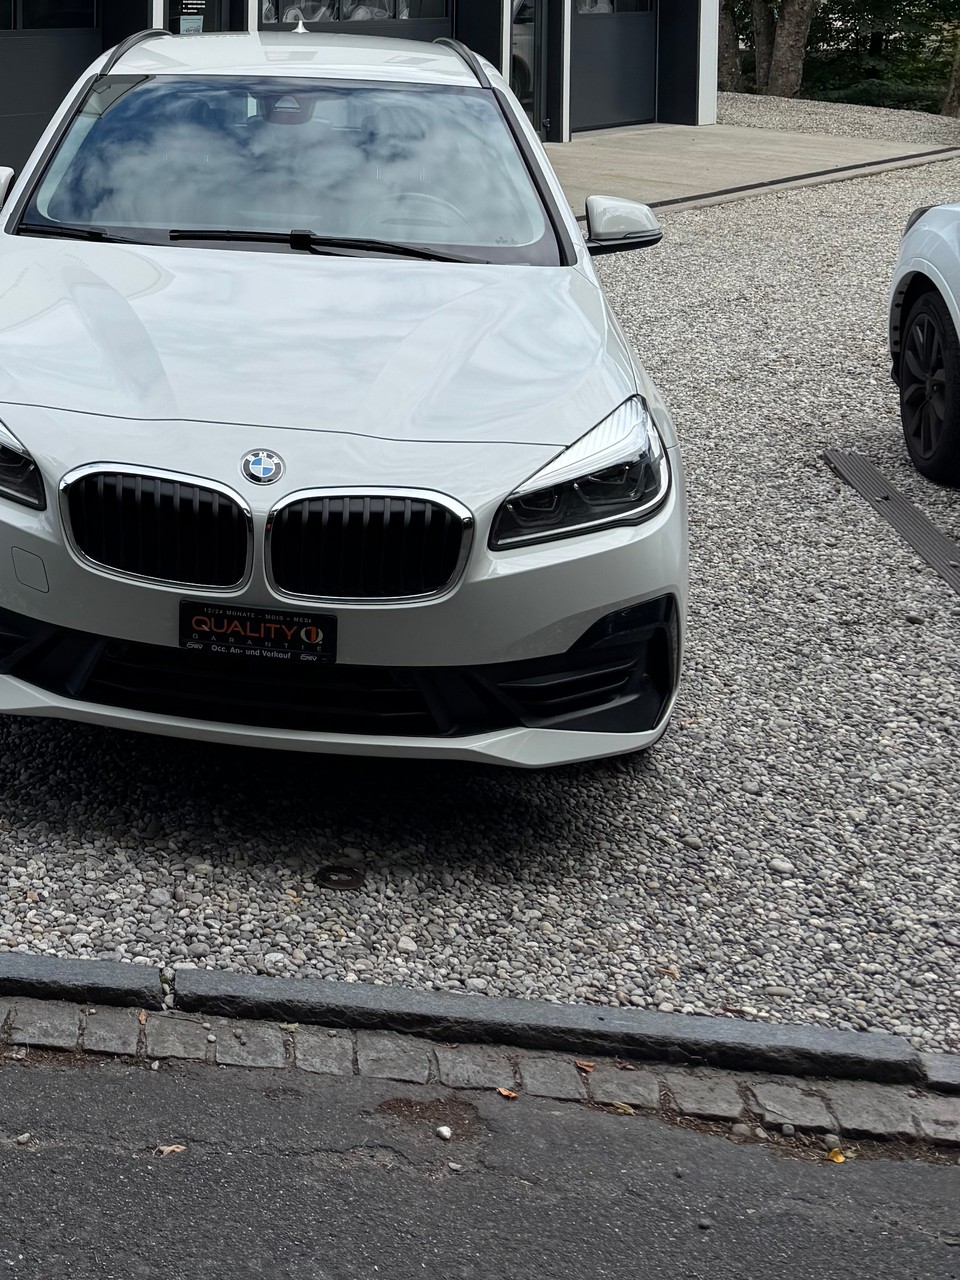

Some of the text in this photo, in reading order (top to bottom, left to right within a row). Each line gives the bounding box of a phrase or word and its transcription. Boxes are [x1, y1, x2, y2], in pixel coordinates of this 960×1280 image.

[203, 607, 223, 615] 12/24
[226, 609, 256, 618] MONATE
[265, 614, 284, 622] MOIS
[191, 615, 298, 641] QUALITY
[192, 632, 322, 653] GARANTIE
[211, 644, 228, 653] Occ.
[229, 646, 244, 655] An-
[245, 649, 260, 657] und
[261, 650, 292, 660] Verkauf
